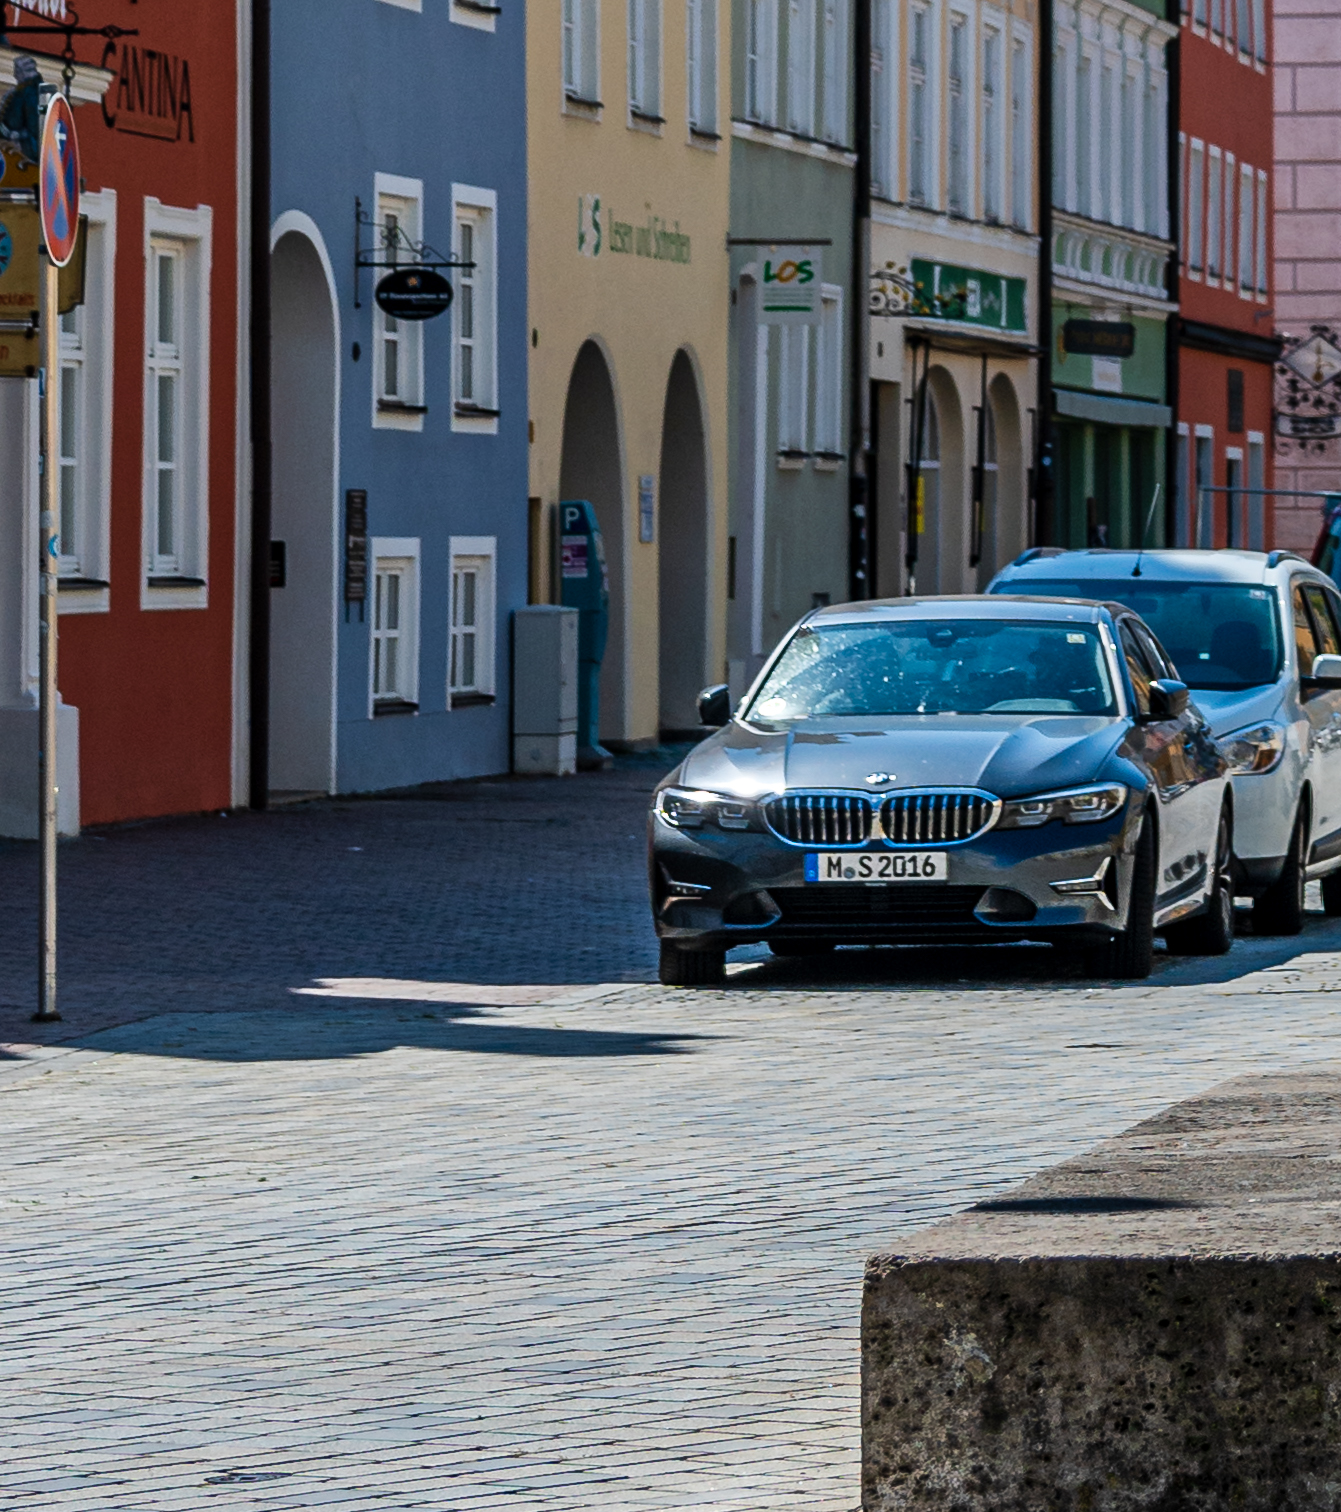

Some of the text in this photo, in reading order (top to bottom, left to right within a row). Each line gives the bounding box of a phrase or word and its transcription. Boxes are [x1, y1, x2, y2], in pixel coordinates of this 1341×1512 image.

[100, 40, 194, 144] CANTINA
[764, 260, 814, 284] LOS
[565, 507, 579, 529] P
[826, 855, 936, 878] M S 2016
